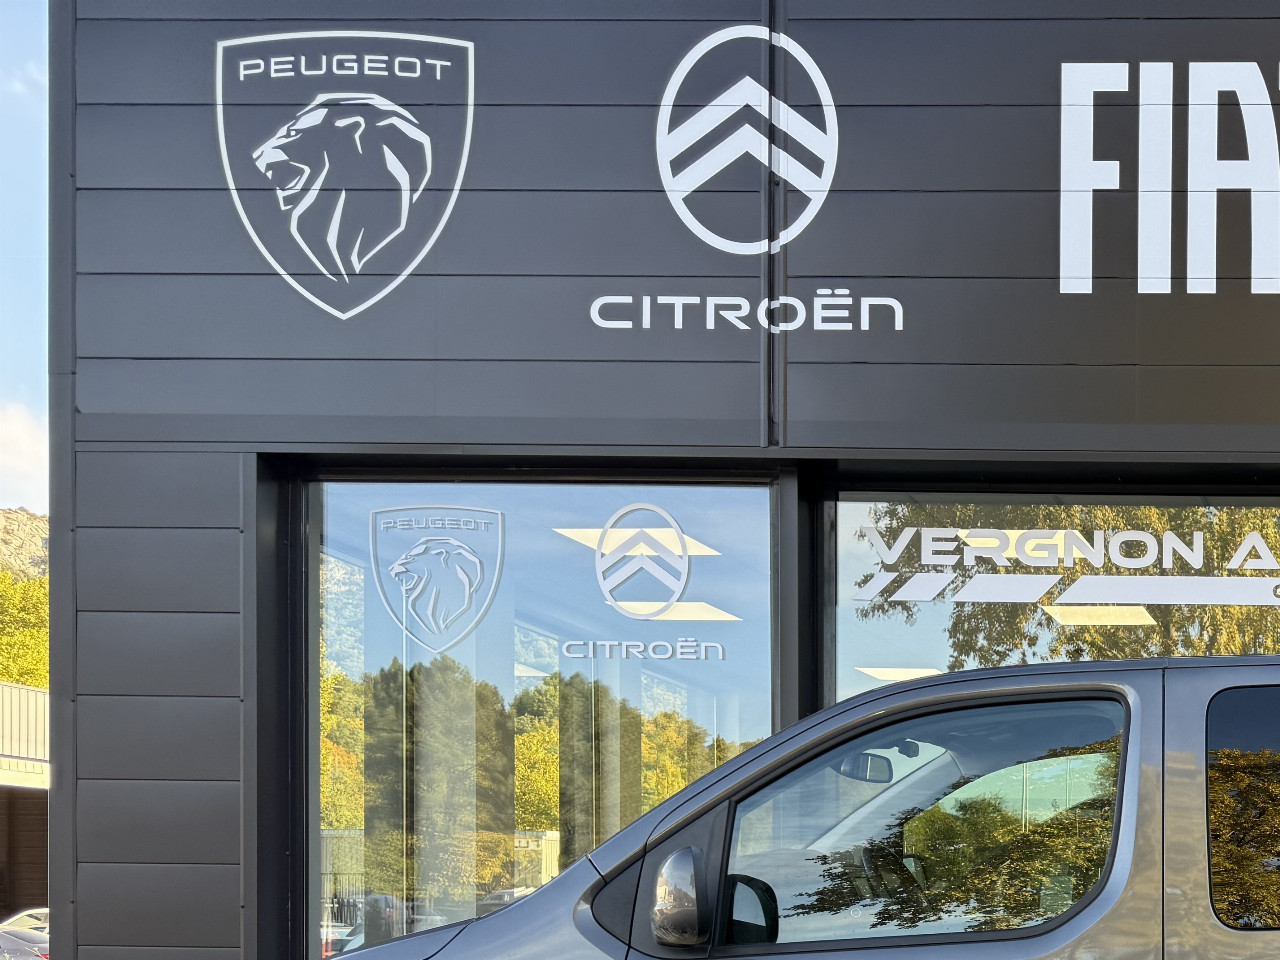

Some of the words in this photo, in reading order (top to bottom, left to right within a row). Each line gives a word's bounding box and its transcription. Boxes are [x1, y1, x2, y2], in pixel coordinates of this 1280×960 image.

[239, 54, 452, 82] PEUGEOT
[380, 516, 494, 532] PEUGEOT
[862, 527, 1203, 568] VERGNON
